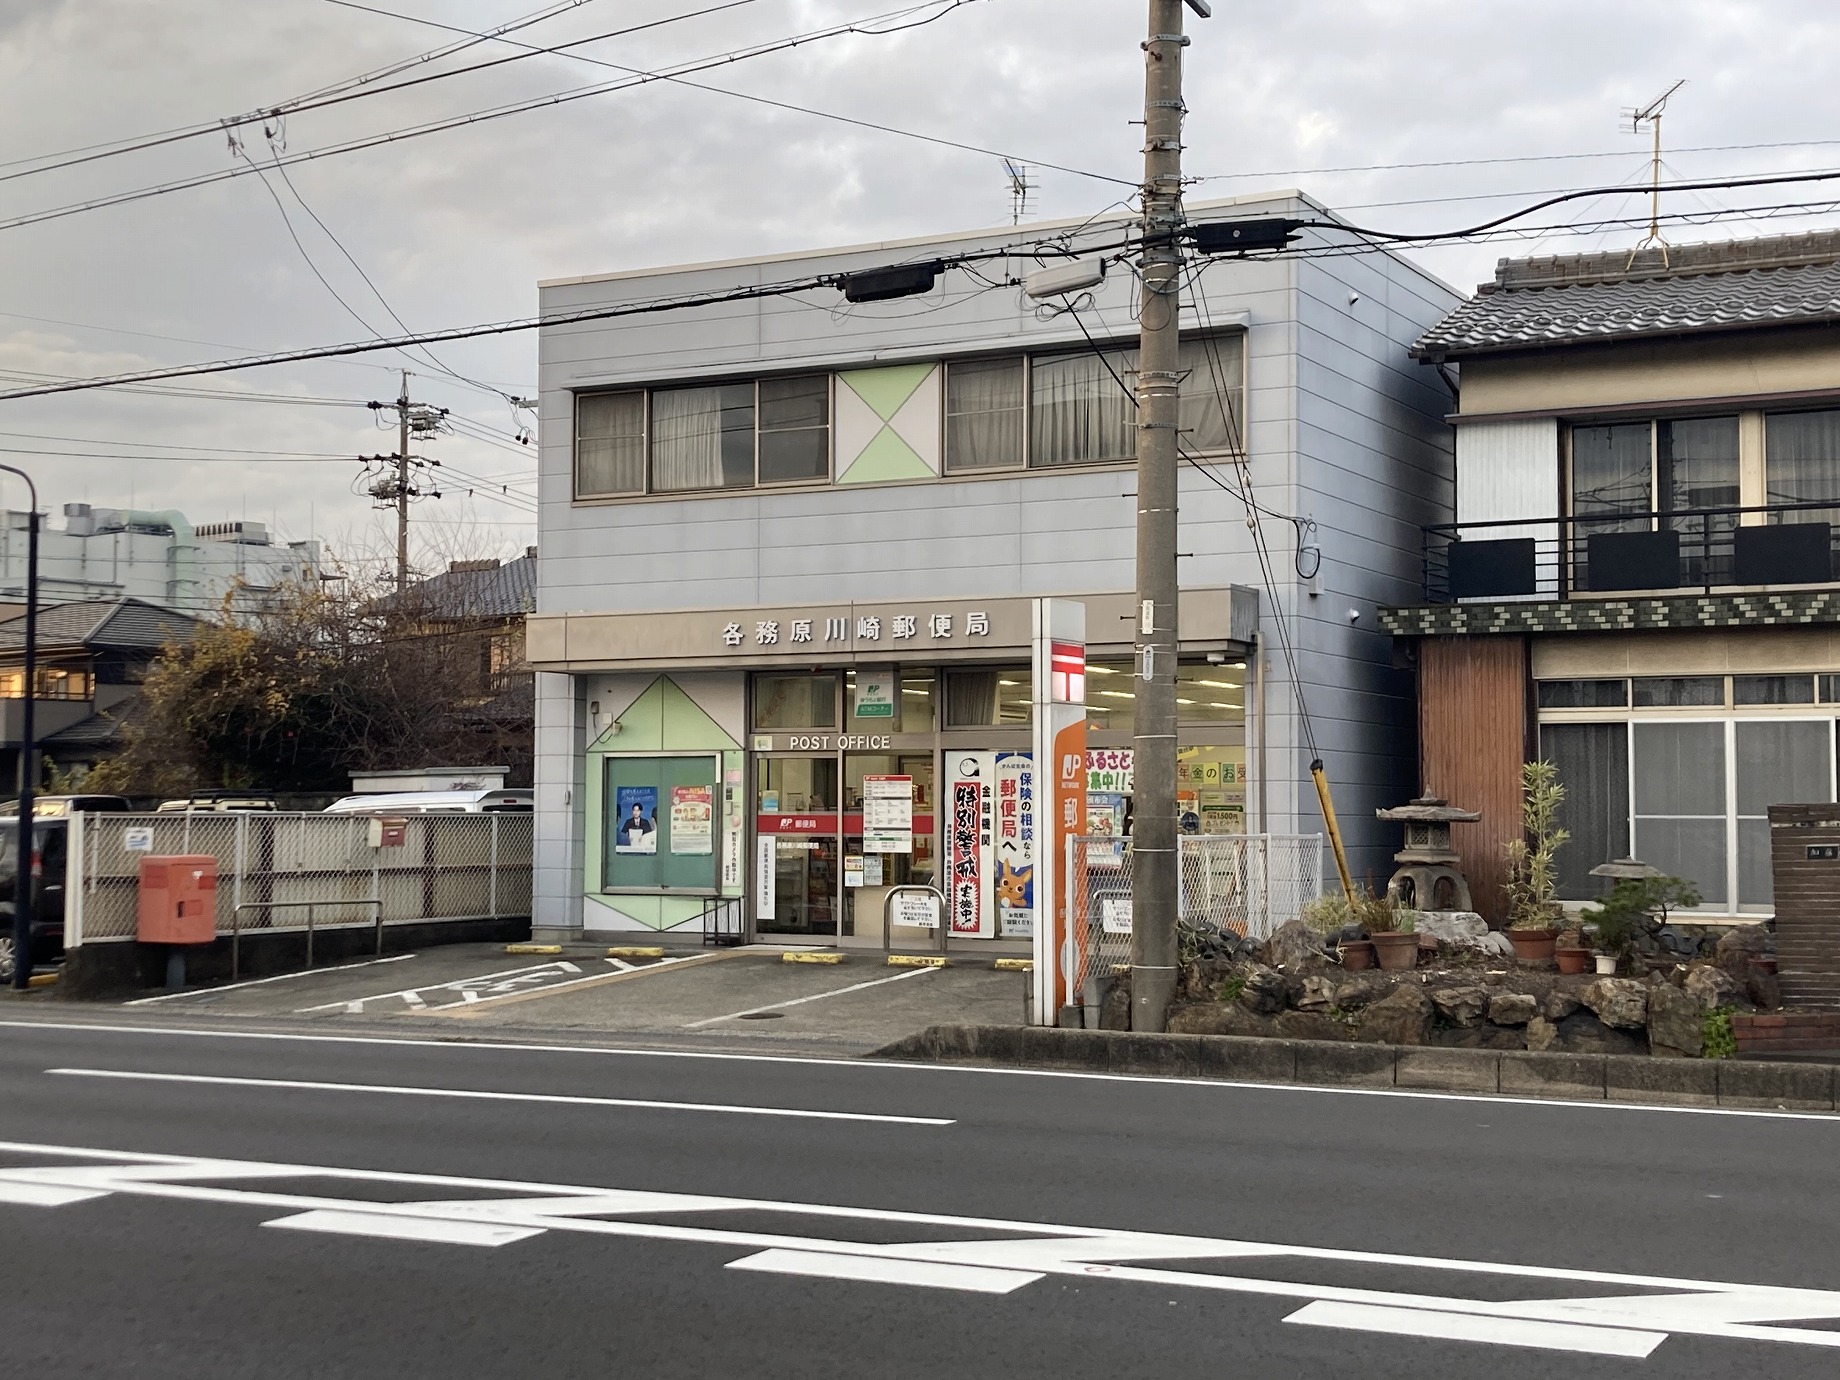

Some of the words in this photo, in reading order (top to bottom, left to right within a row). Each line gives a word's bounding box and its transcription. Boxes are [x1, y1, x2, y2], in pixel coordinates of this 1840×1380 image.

[722, 611, 991, 647] 各務原川崎郵便局
[790, 736, 830, 750] POST
[837, 735, 891, 749] OFFICE
[1086, 751, 1134, 770] ふるさと
[795, 819, 817, 829] 郵便局
[955, 785, 979, 879] 特別警戒
[981, 785, 991, 847] 金融機関
[1000, 778, 1017, 853] 郵便局へ
[1019, 772, 1033, 860] 保険の相談なら
